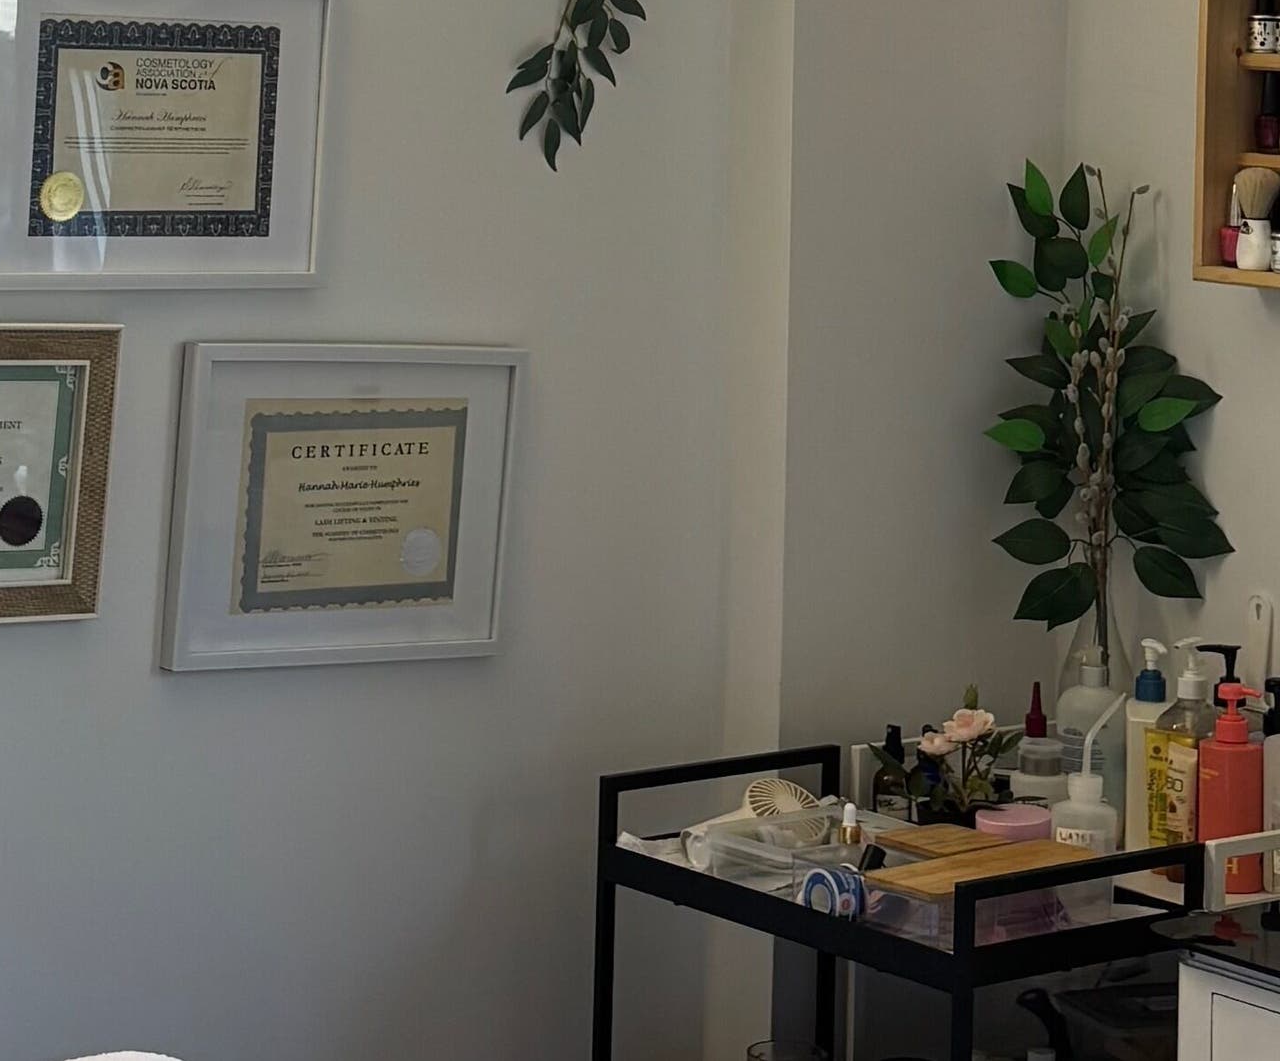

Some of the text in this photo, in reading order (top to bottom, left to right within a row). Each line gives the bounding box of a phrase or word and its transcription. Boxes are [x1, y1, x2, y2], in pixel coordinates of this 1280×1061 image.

[136, 58, 214, 69] COSMETOLOGY
[136, 68, 196, 78] ASSOCIATION
[136, 78, 216, 90] NOVA SCOTIA
[292, 442, 429, 459] CERTIFICATE
